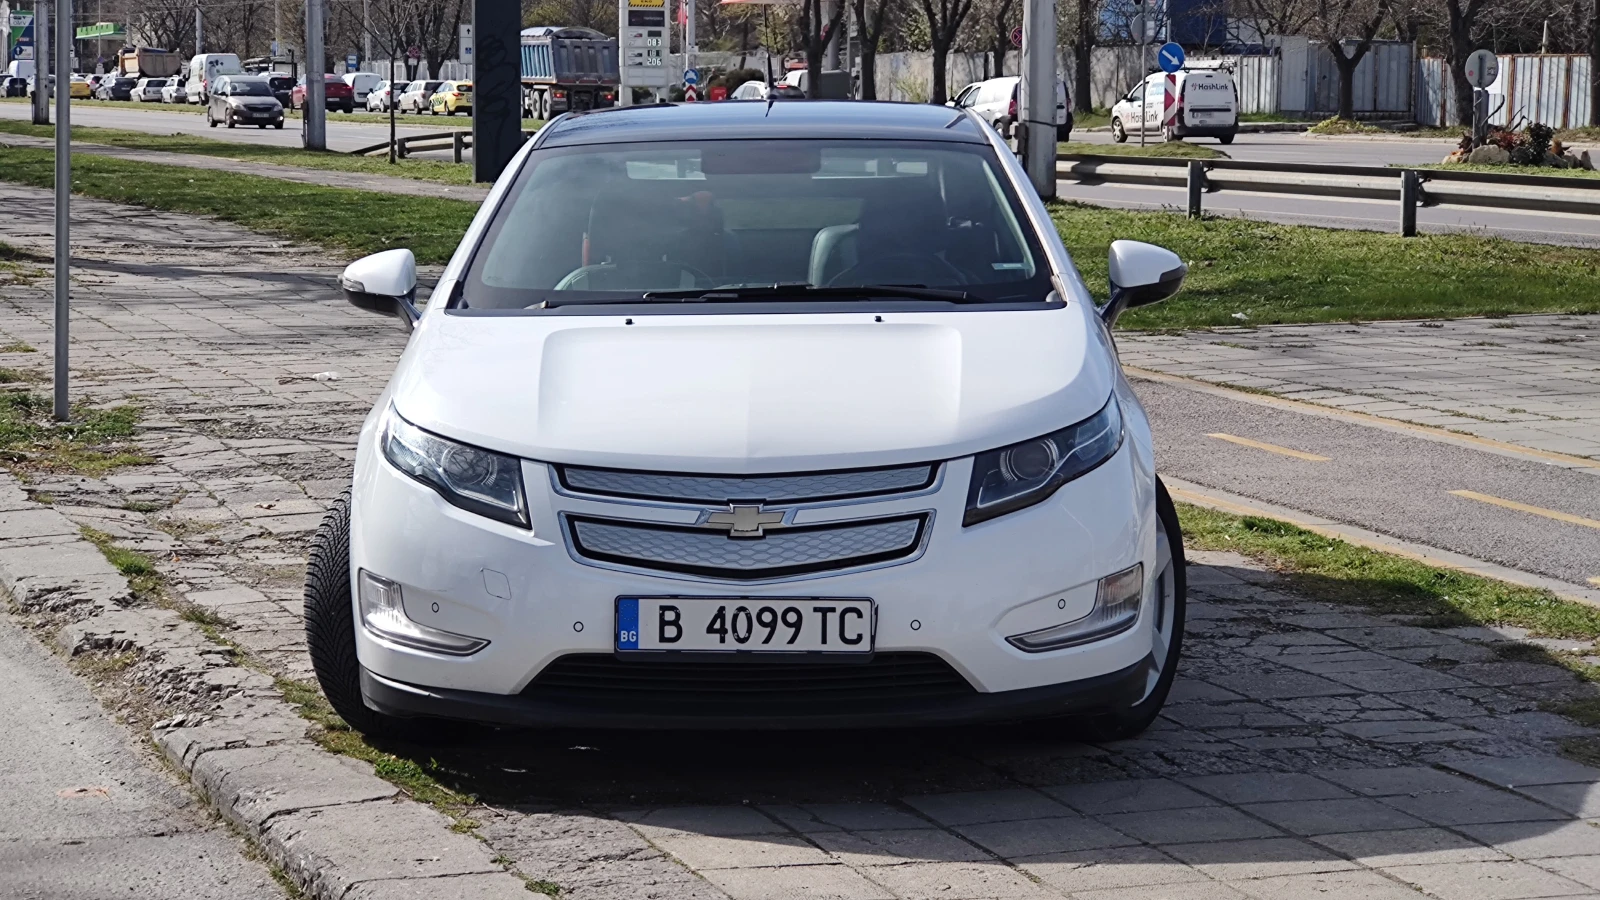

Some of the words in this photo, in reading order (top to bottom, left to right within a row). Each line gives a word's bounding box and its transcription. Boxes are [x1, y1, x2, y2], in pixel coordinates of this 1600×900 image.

[647, 58, 662, 66] 206
[1130, 110, 1158, 123] HasLink
[658, 605, 683, 644] B
[705, 605, 803, 645] 4099
[812, 606, 864, 646] TC
[620, 630, 637, 642] BG
